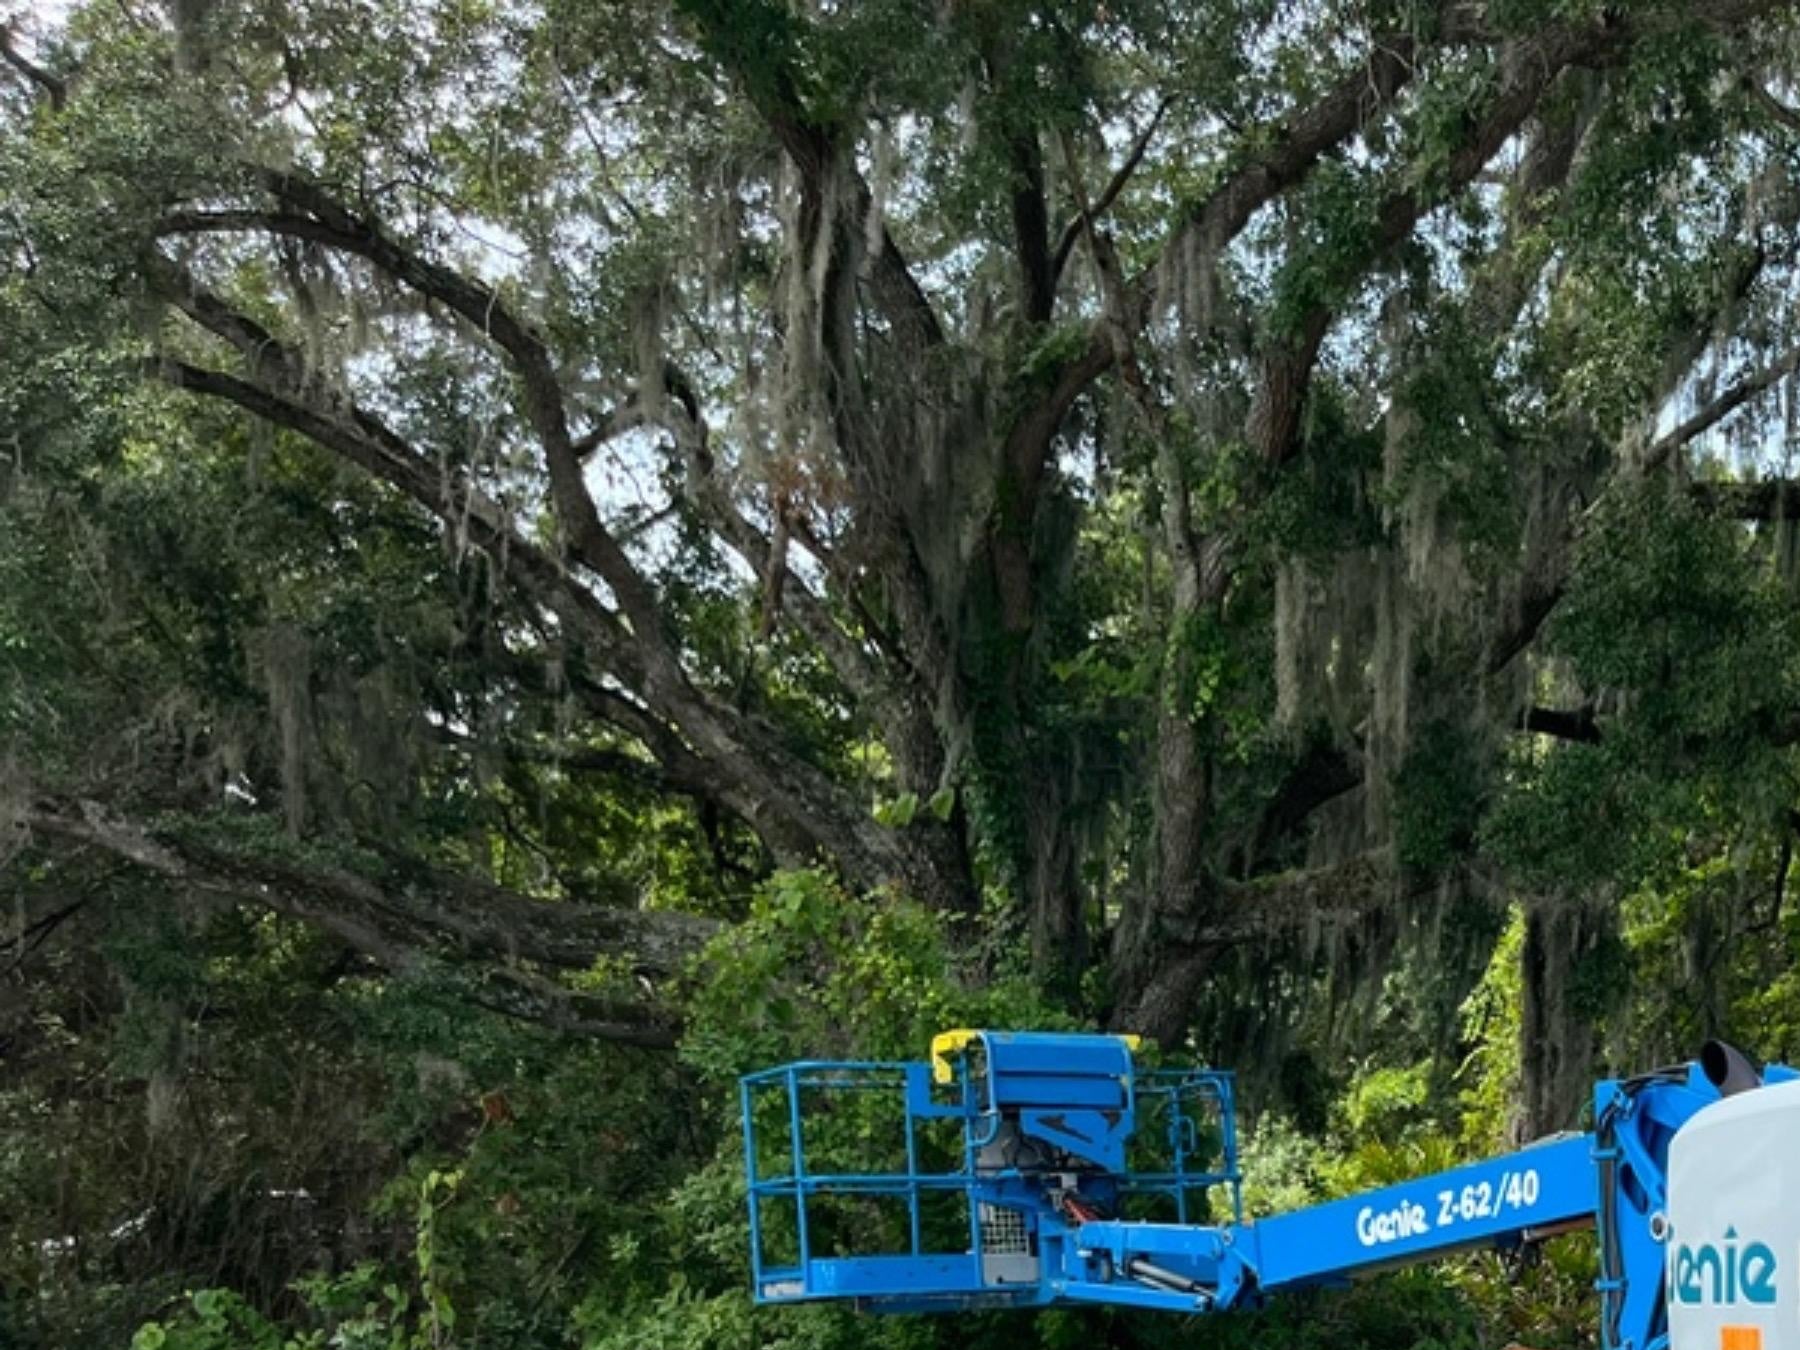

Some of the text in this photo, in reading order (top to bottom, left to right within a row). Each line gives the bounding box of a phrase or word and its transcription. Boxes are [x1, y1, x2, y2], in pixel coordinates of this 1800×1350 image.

[1356, 1168, 1541, 1247] Genie Z-62/40
[1666, 1223, 1778, 1305] enie
